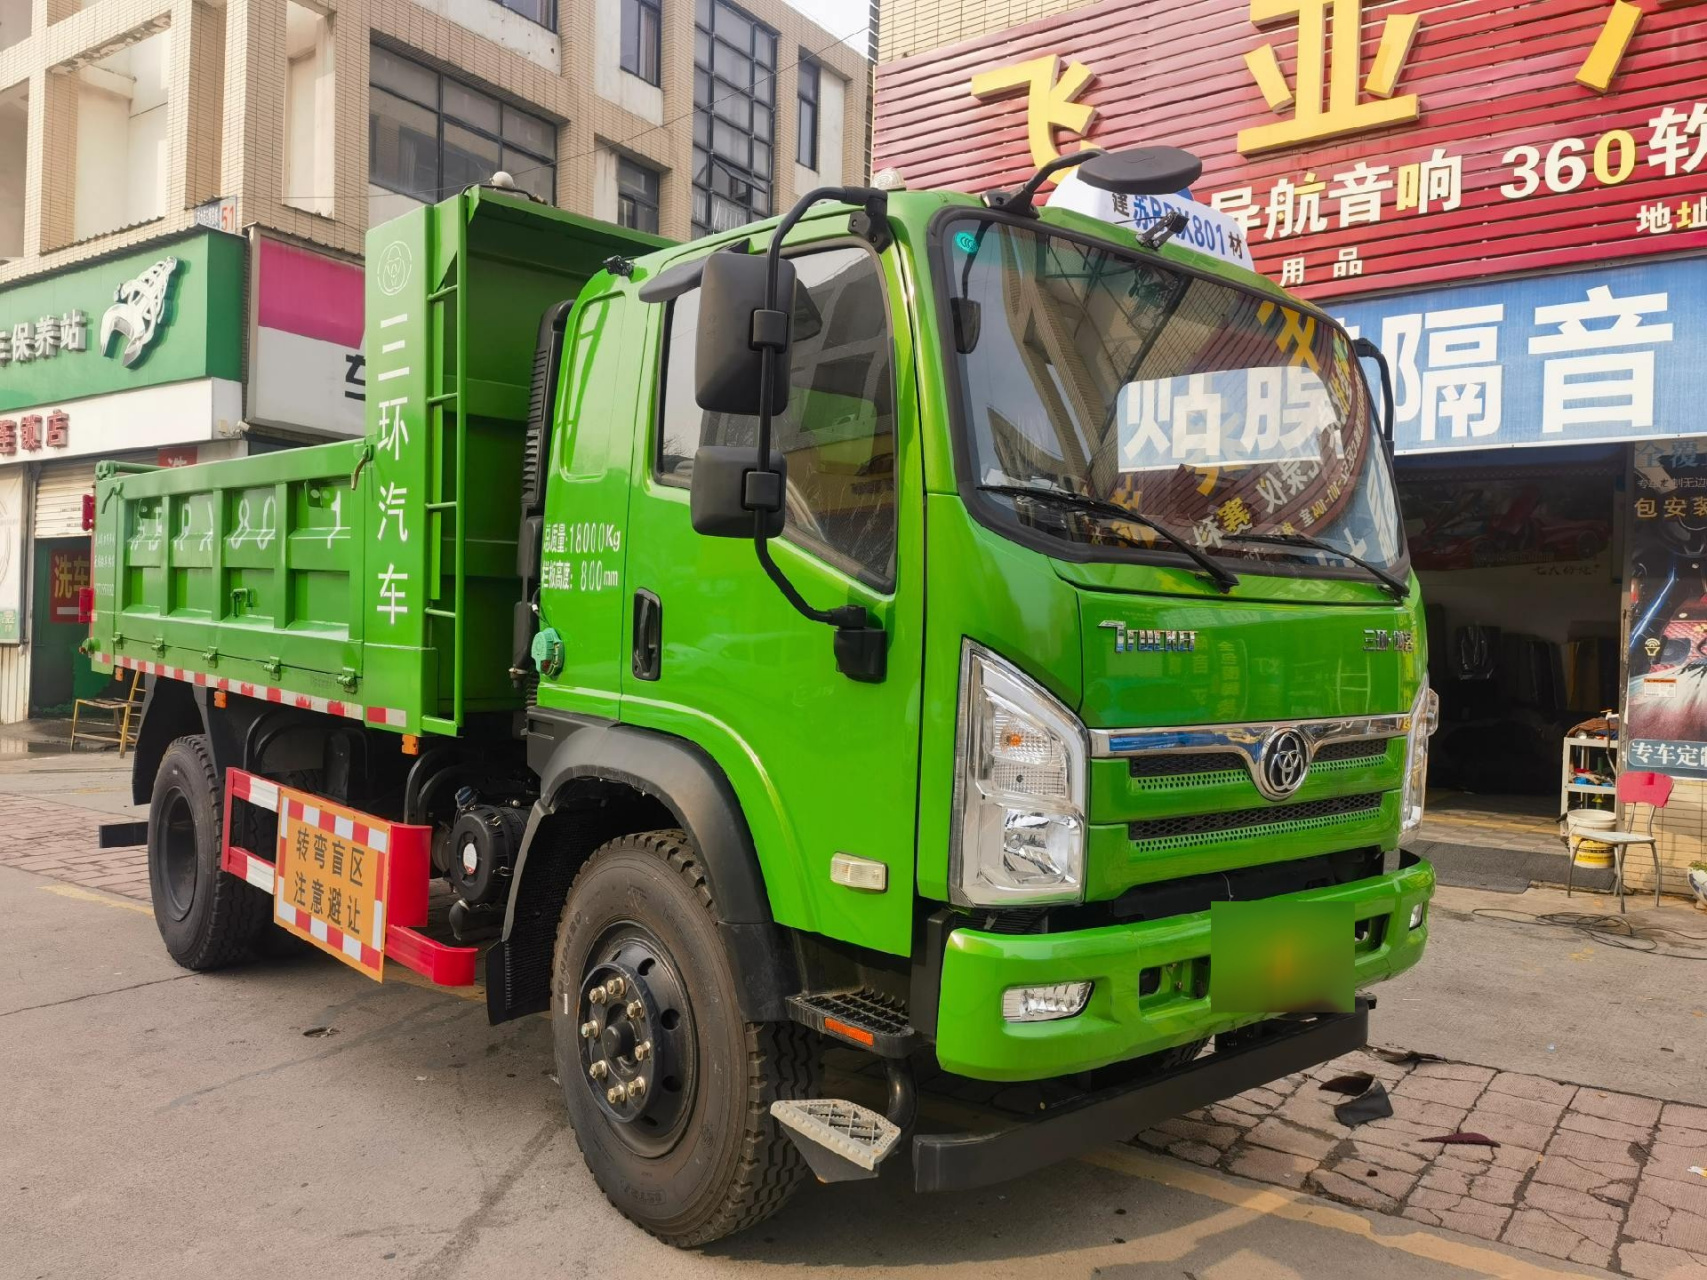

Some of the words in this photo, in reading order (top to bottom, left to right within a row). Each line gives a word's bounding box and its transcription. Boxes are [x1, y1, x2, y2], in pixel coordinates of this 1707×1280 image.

[221, 205, 234, 230] 51
[1227, 232, 1243, 259] 材
[377, 313, 410, 625] 三环汽车
[296, 827, 365, 887] 转弯盲区
[293, 870, 361, 934] 注意避让
